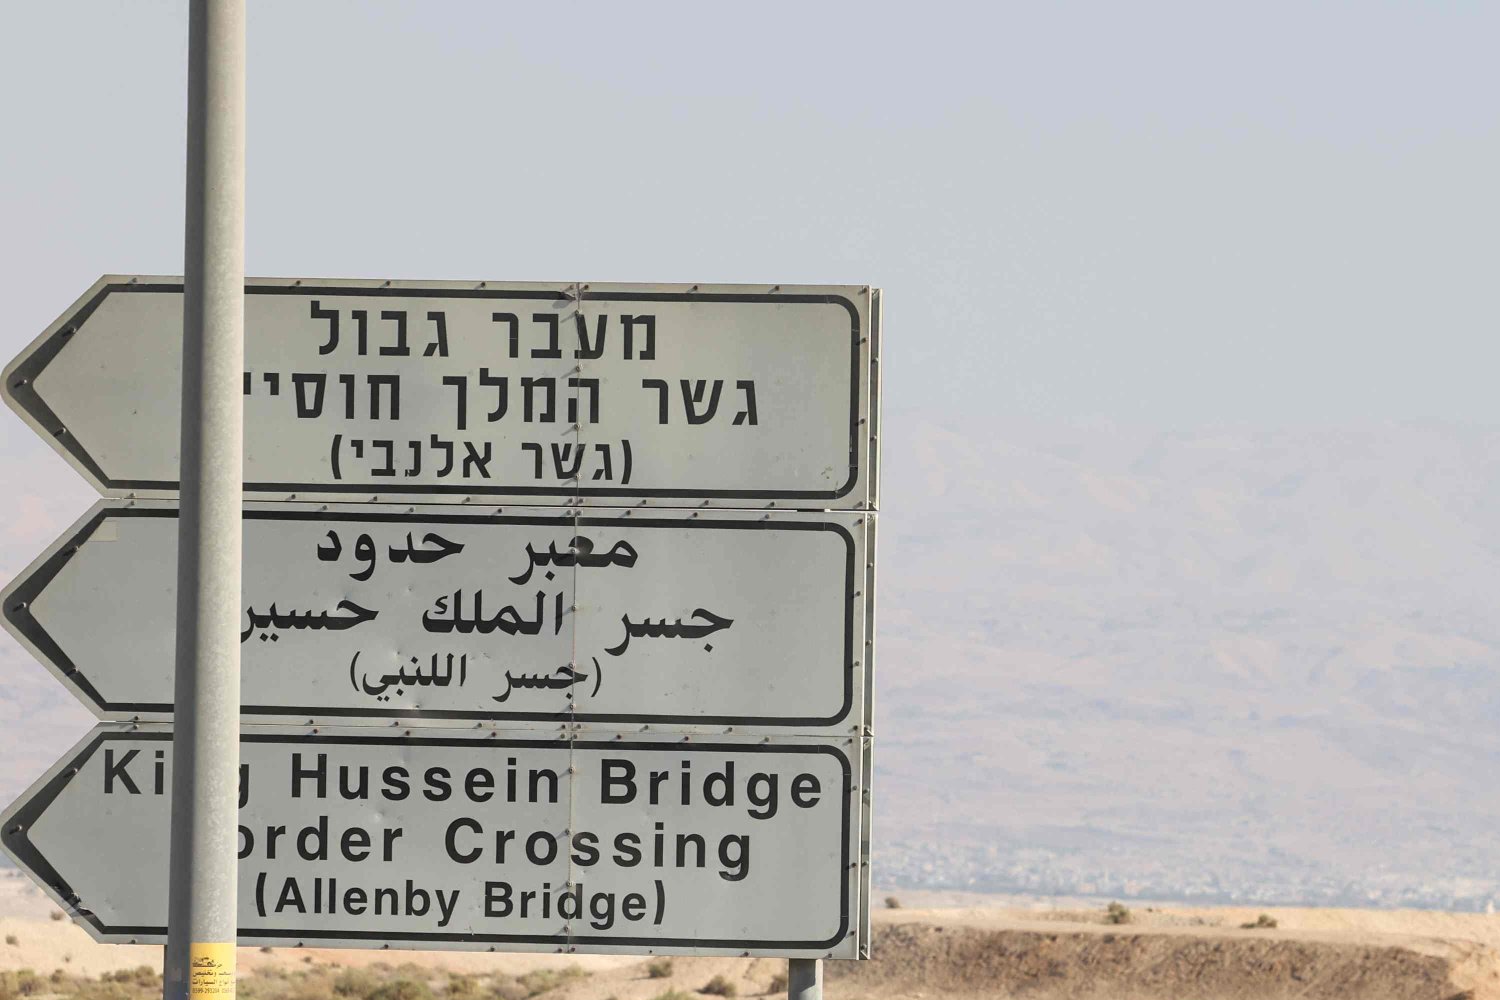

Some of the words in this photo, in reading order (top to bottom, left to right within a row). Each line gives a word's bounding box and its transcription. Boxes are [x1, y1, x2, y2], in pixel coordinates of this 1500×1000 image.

[310, 300, 450, 358] גבול
[492, 312, 656, 361] מעבר
[244, 371, 400, 420] חוסיי
[443, 367, 600, 431] המלך
[642, 378, 759, 426] גשר
[331, 434, 492, 480] אלנבי)
[521, 439, 633, 485] (גשר
[316, 529, 466, 582] حدود
[508, 536, 640, 585] معبر
[421, 589, 565, 637] الملك
[604, 605, 735, 657] جسر
[350, 651, 467, 702] اللنبي)
[492, 656, 602, 702] (جسر
[104, 749, 250, 809] Ki
[291, 752, 559, 803] Hussein
[600, 758, 821, 820] Bridge
[237, 815, 403, 862] order
[444, 816, 751, 882] Crossing
[255, 872, 461, 928] (Allenby
[484, 879, 667, 931] Bridge)
